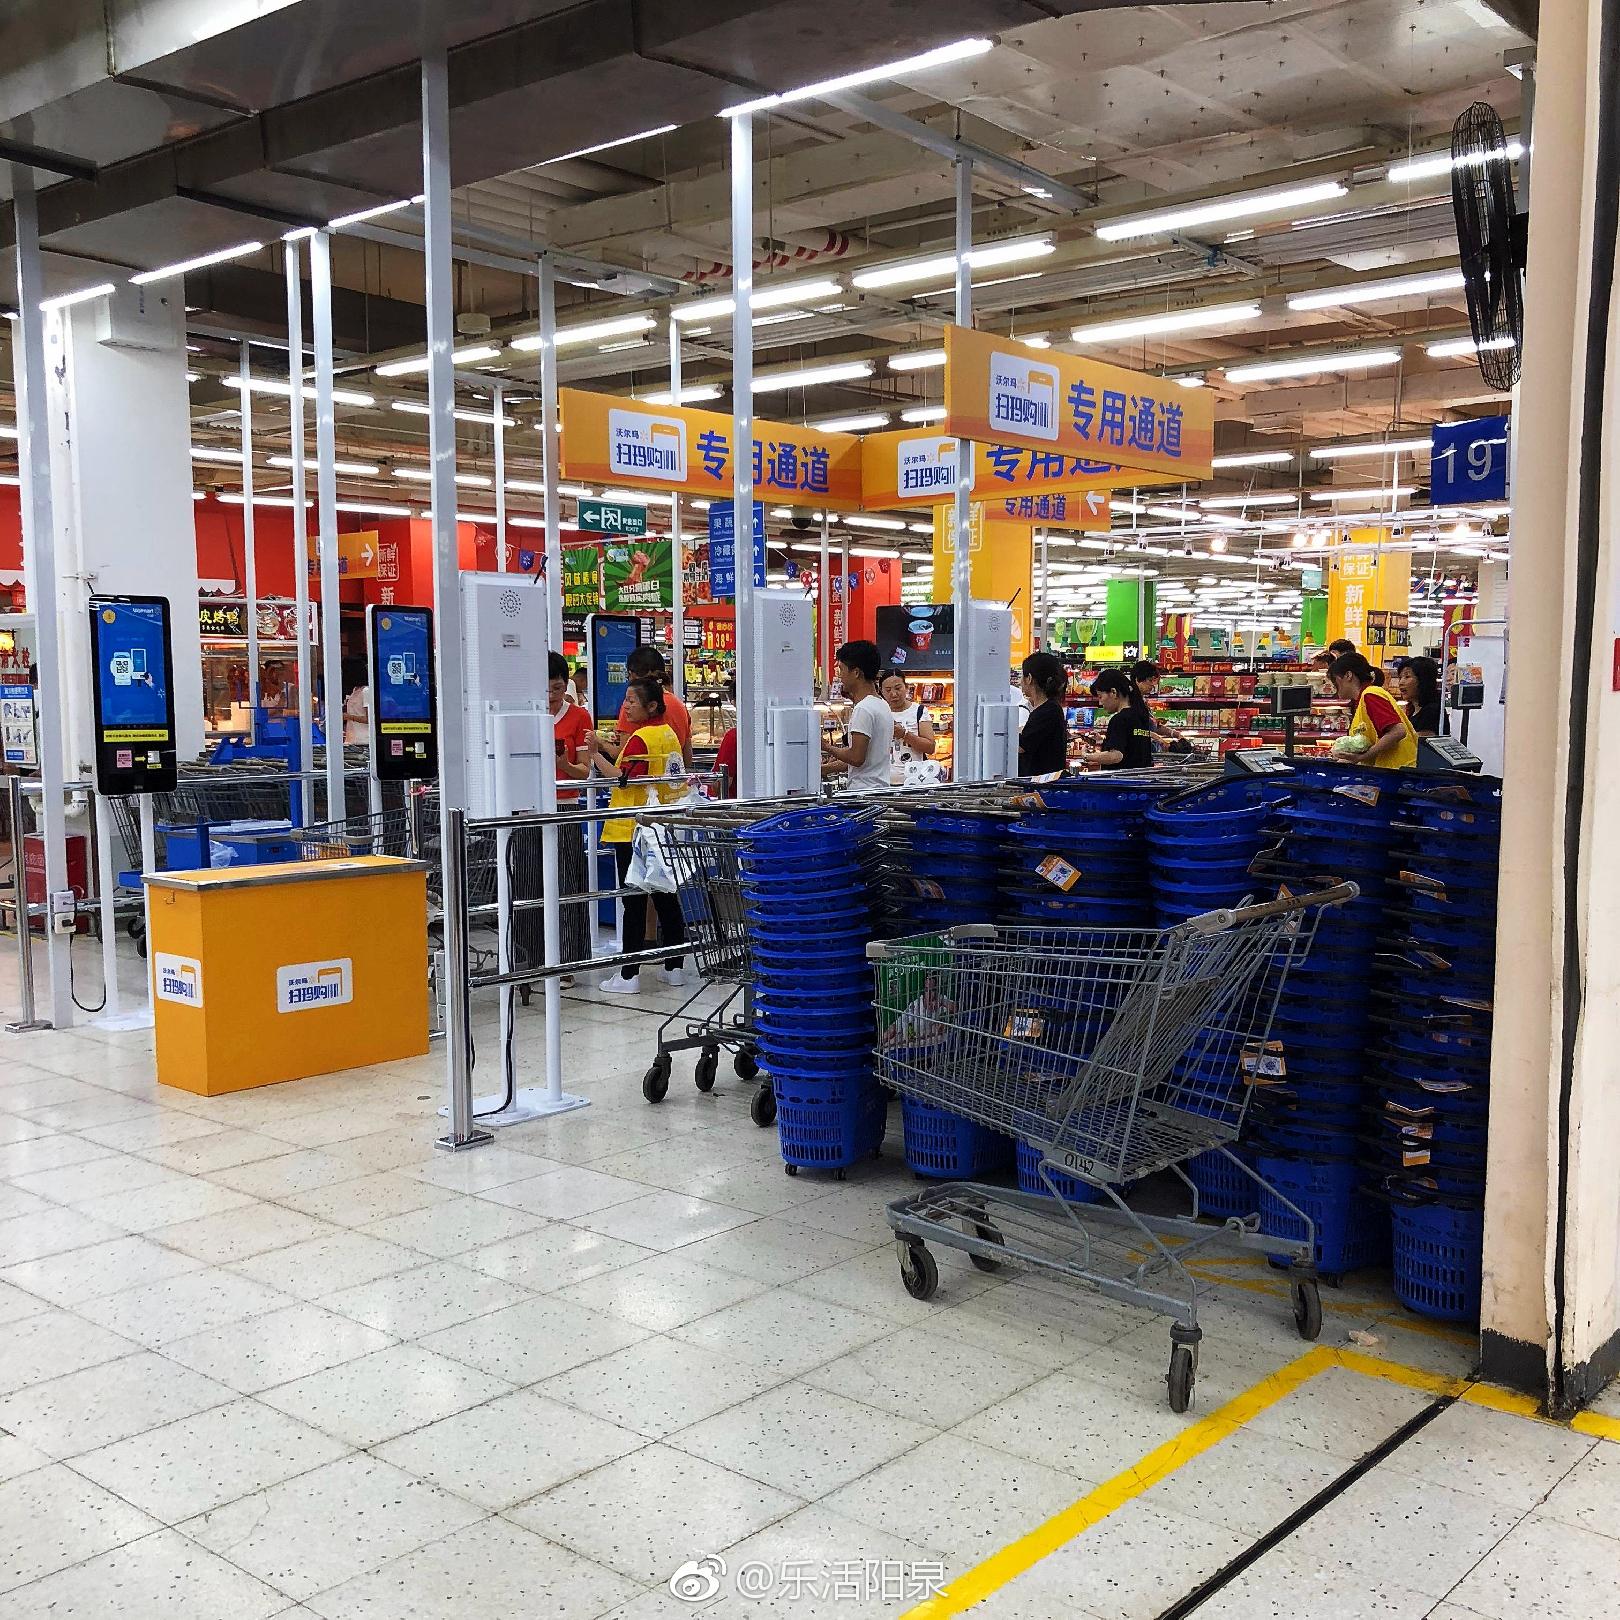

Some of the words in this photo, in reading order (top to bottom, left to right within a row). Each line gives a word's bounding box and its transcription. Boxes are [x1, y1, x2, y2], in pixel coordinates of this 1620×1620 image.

[996, 374, 1017, 389] 沃尔玛
[995, 393, 1037, 426] 扫玛购
[1067, 379, 1183, 457] 专用通道
[615, 427, 639, 439] 沃尔玛
[616, 442, 663, 470] 扫玛购
[903, 453, 926, 465] 沃尔玛
[986, 444, 1119, 483] 专用
[1441, 439, 1492, 484] 19
[903, 465, 950, 489] 扫玛购
[1004, 493, 1066, 521] 专用通道
[714, 571, 735, 584] 海鲜
[1343, 562, 1369, 575] 保证
[288, 985, 328, 1004] 扫玛购
